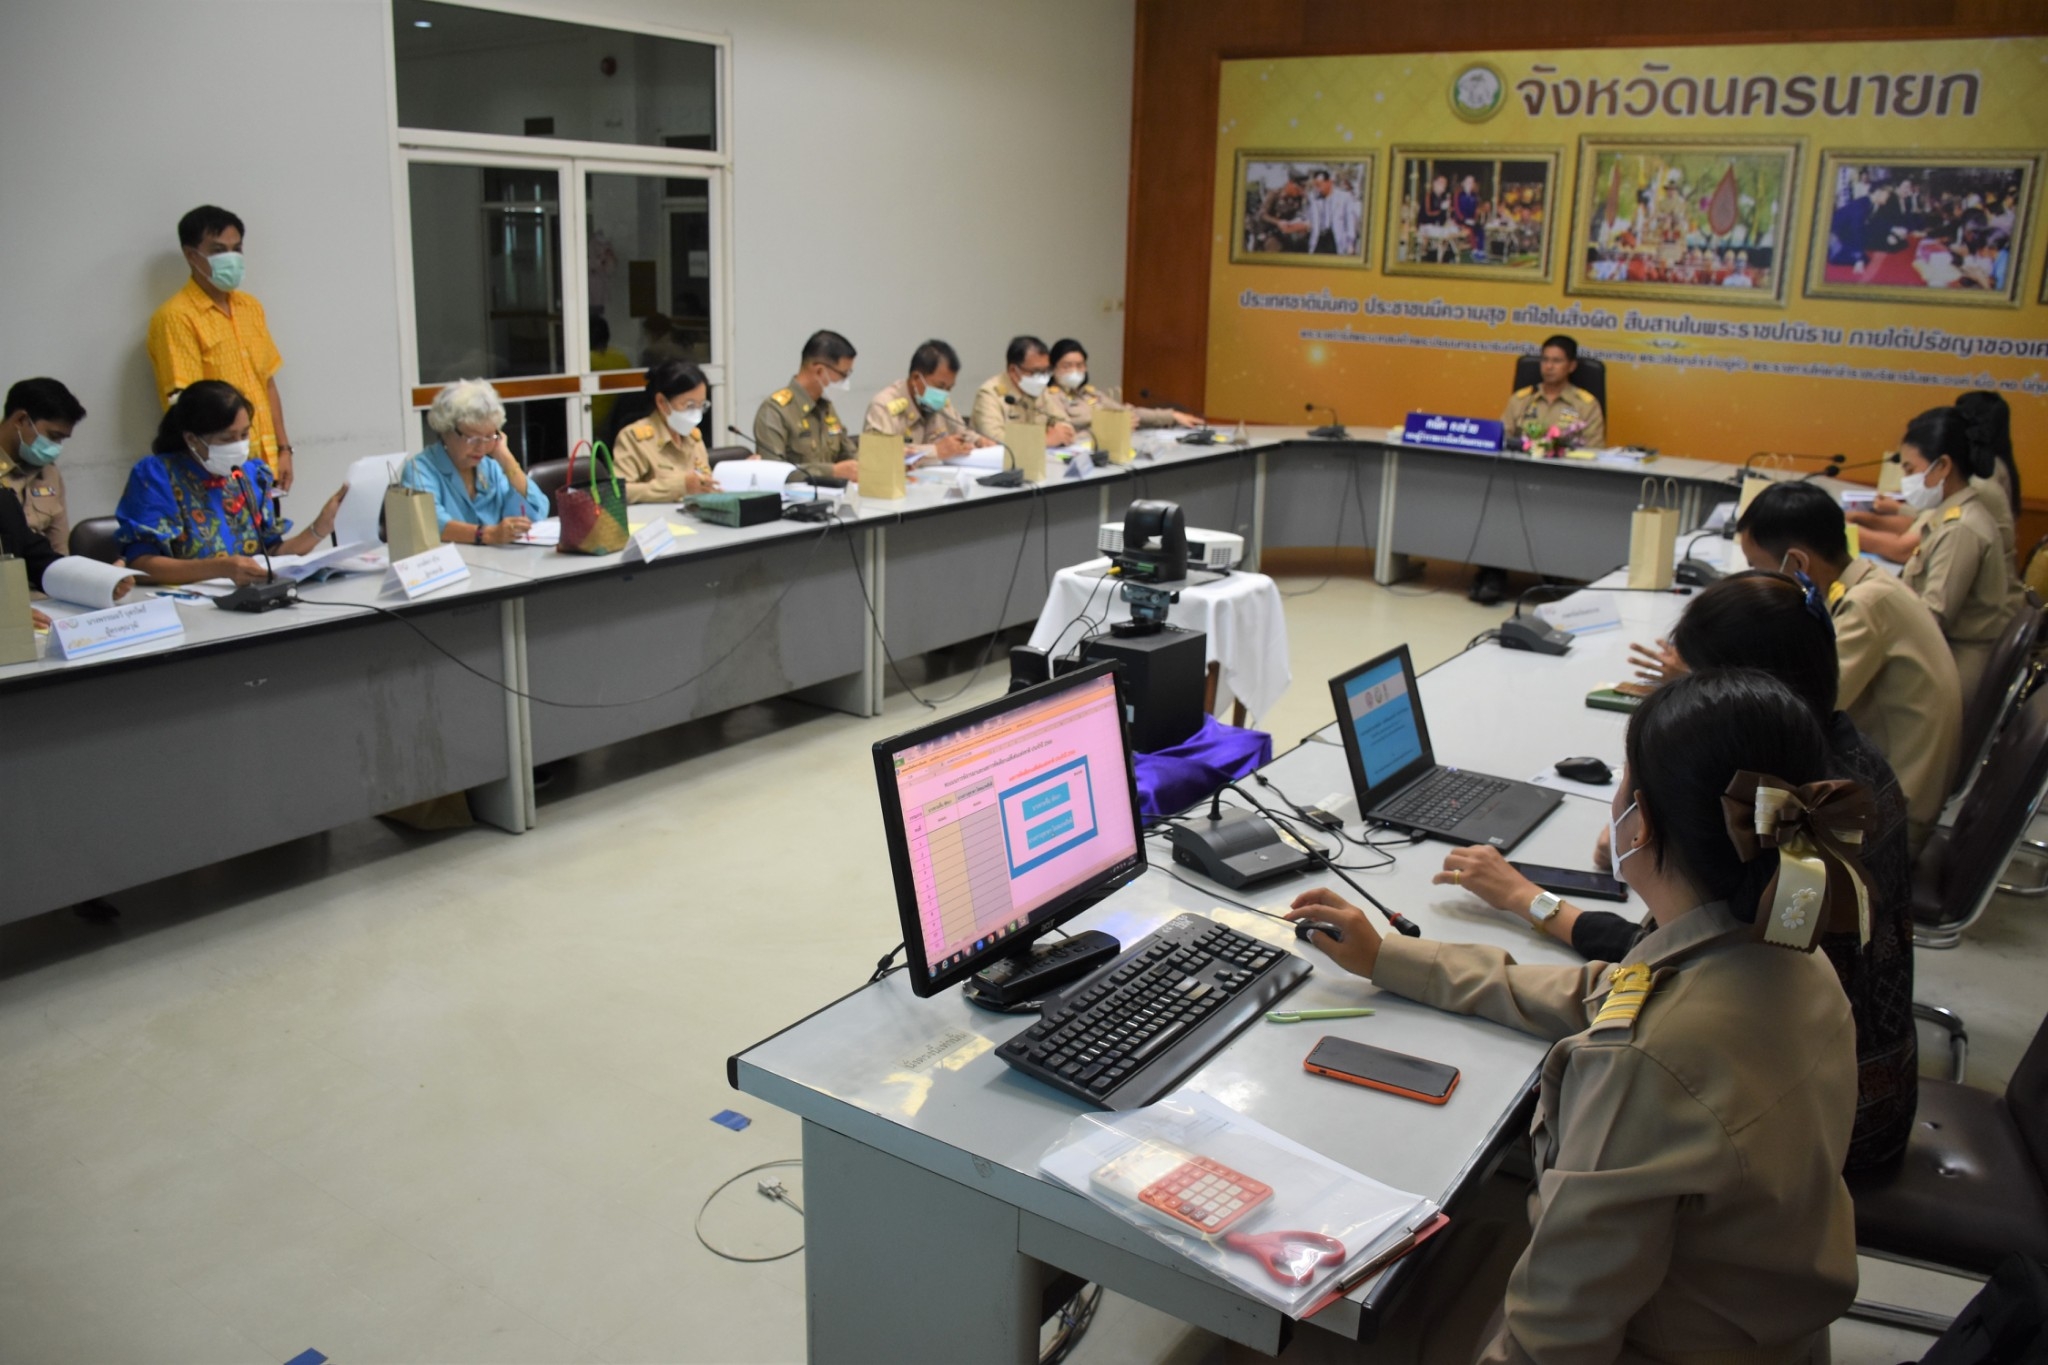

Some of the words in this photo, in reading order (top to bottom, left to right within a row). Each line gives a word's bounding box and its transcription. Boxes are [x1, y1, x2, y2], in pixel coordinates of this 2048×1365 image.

[1515, 62, 1980, 117] จังหวัดนครนายก
[1364, 295, 1506, 327] ประชาชนมีความสุข
[1040, 917, 1056, 933] acer
